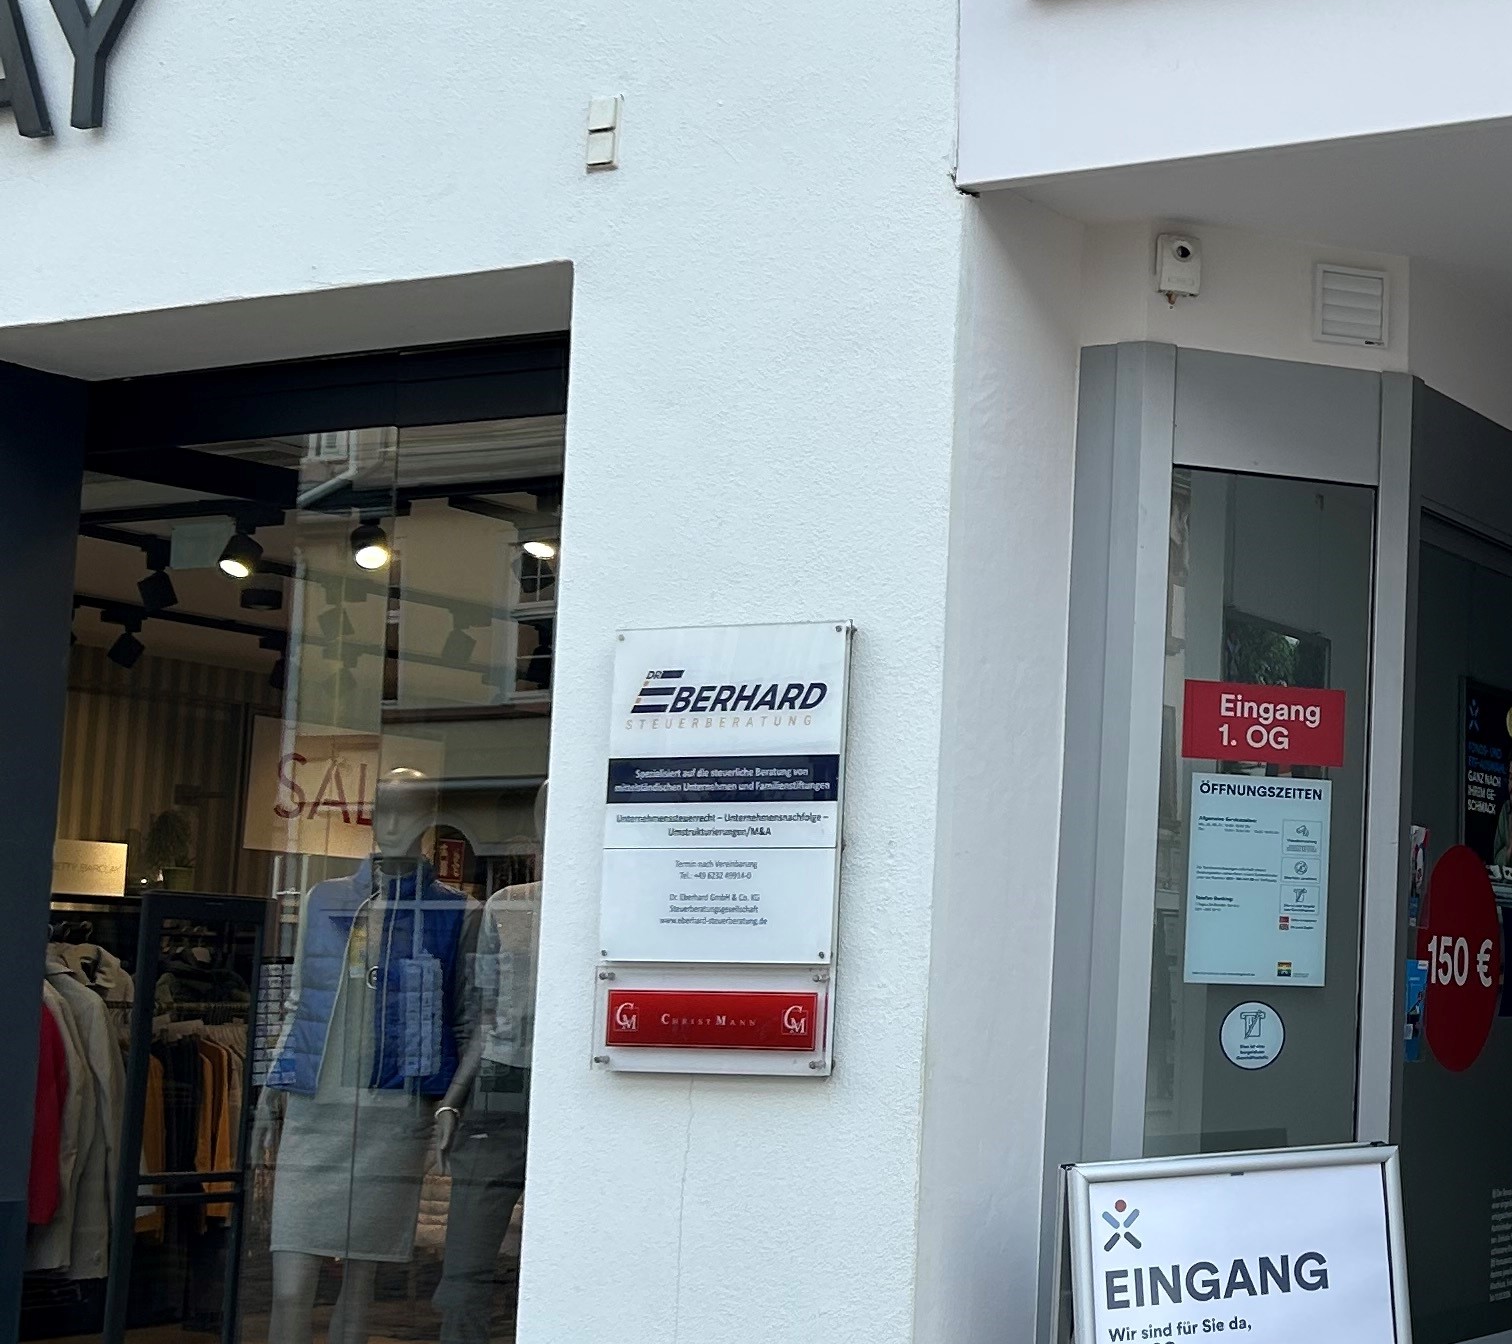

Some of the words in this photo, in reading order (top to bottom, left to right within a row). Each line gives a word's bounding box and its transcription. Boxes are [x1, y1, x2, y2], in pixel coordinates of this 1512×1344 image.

[625, 714, 813, 731] STEUERBERATUNG
[1220, 693, 1320, 728] Eingang
[1218, 723, 1237, 746] 1.
[1246, 724, 1289, 750] OG
[635, 768, 682, 780] Spezialisiert
[682, 768, 696, 778] auf
[696, 768, 709, 778] die
[711, 767, 754, 778] steuerliche
[755, 767, 792, 780] Beratung
[792, 767, 809, 777] von
[738, 781, 754, 791] und
[273, 751, 373, 826] SAL
[1199, 780, 1323, 801] ÖFFNUNGSZEITEN
[1428, 935, 1469, 987] 150
[1476, 938, 1493, 988] €
[1105, 1251, 1329, 1310] EINGANG
[1108, 1327, 1138, 1344] Wir
[1141, 1322, 1173, 1340] sind
[1176, 1319, 1199, 1337] für
[1202, 1317, 1225, 1334] Sie
[1228, 1315, 1252, 1332] da,
